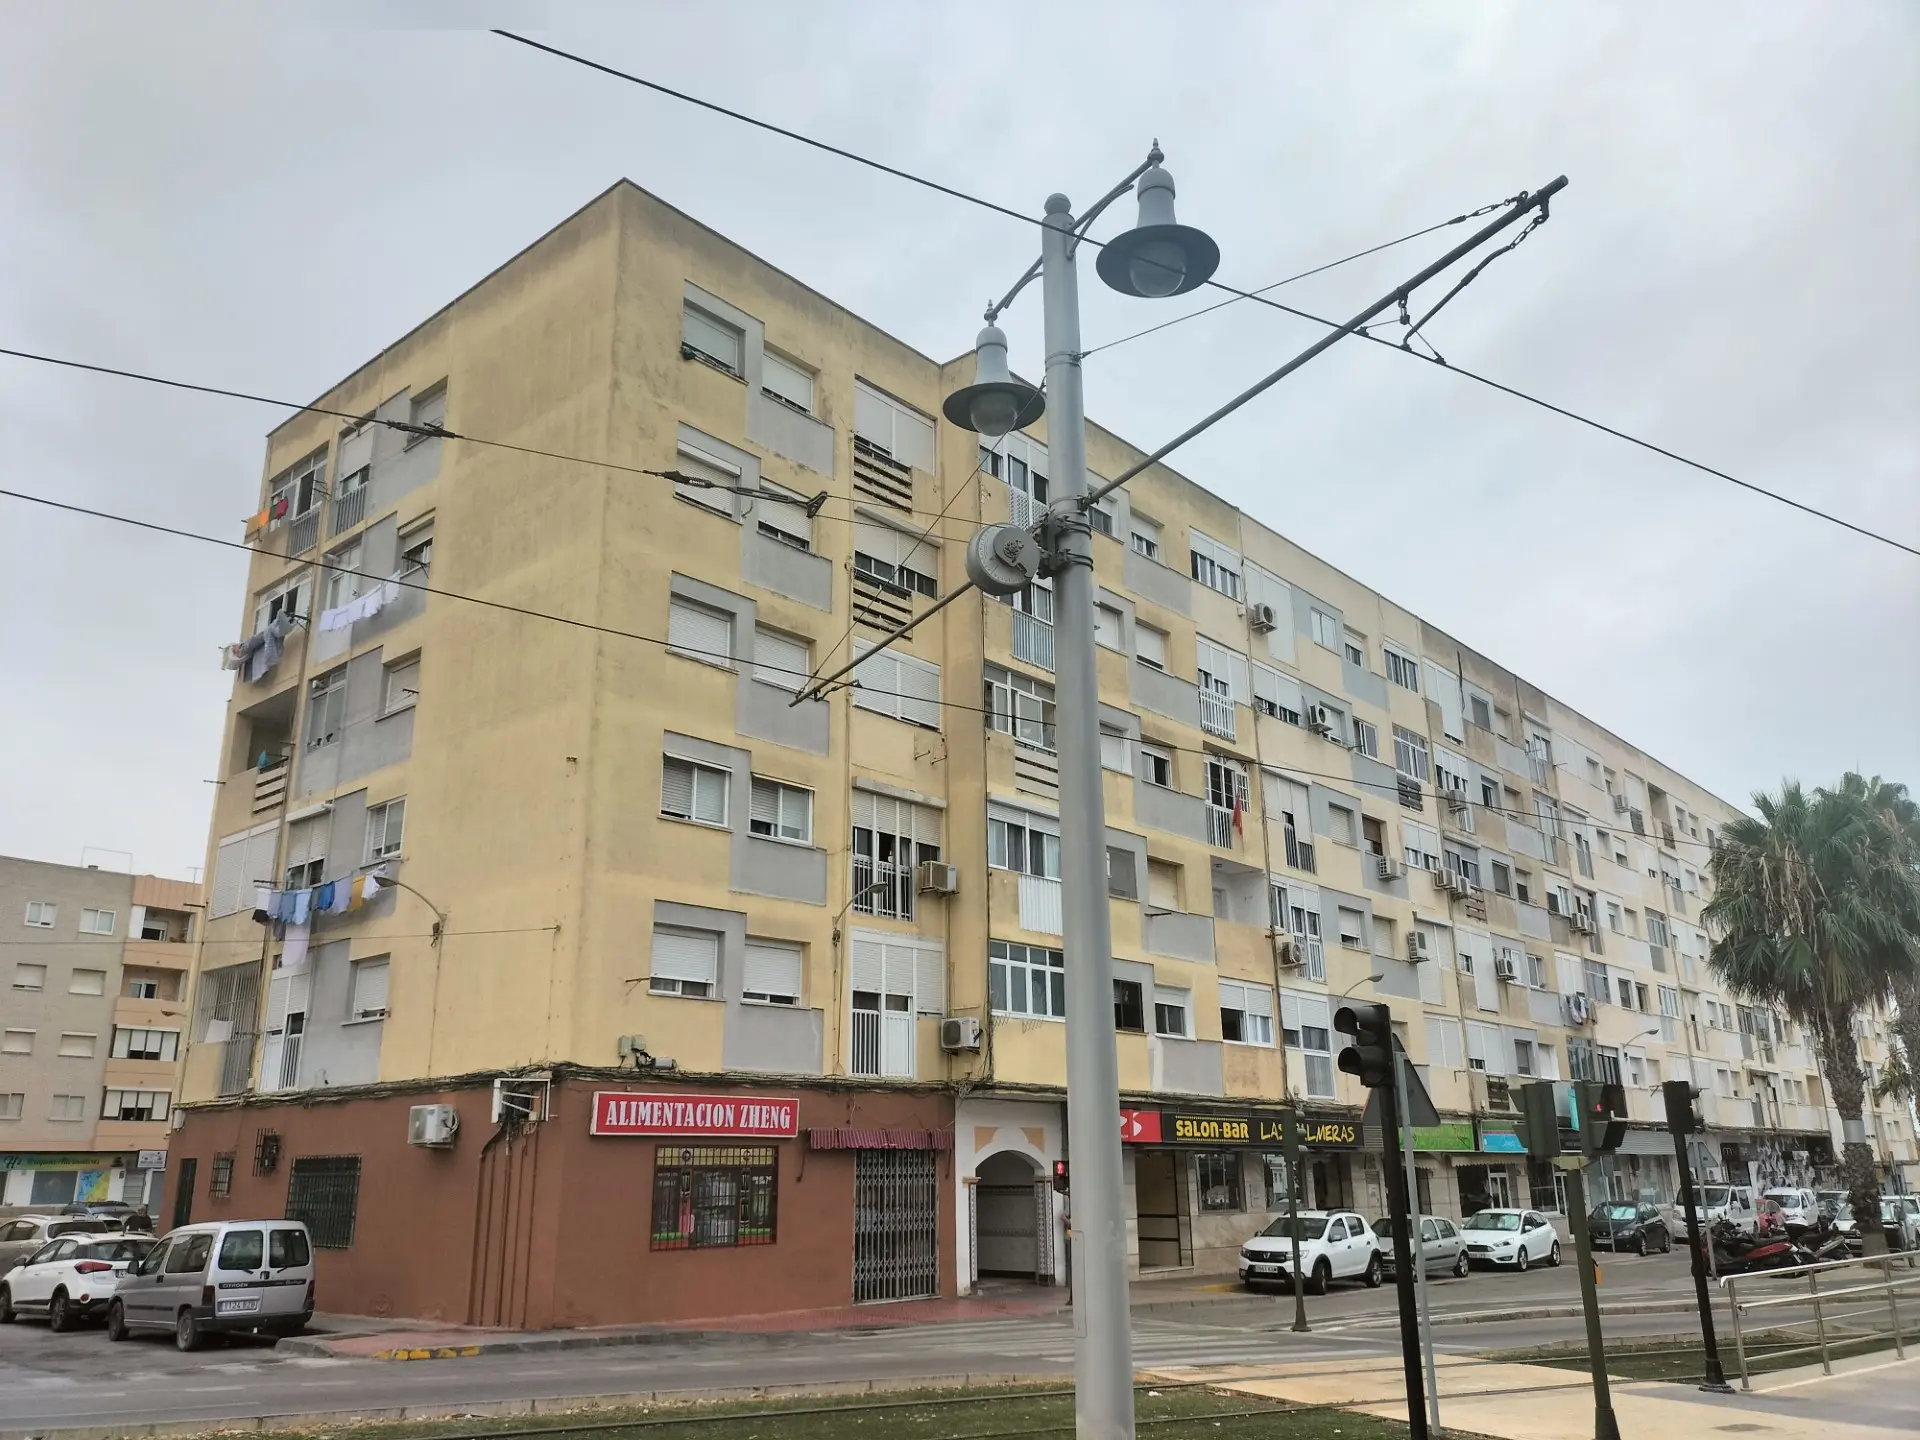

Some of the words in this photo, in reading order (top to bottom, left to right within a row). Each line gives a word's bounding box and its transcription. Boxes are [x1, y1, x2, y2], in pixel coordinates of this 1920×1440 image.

[605, 1101, 735, 1128] ALIMENTACION
[739, 1104, 791, 1129] ZHENG
[1296, 1122, 1355, 1143] LMERAS
